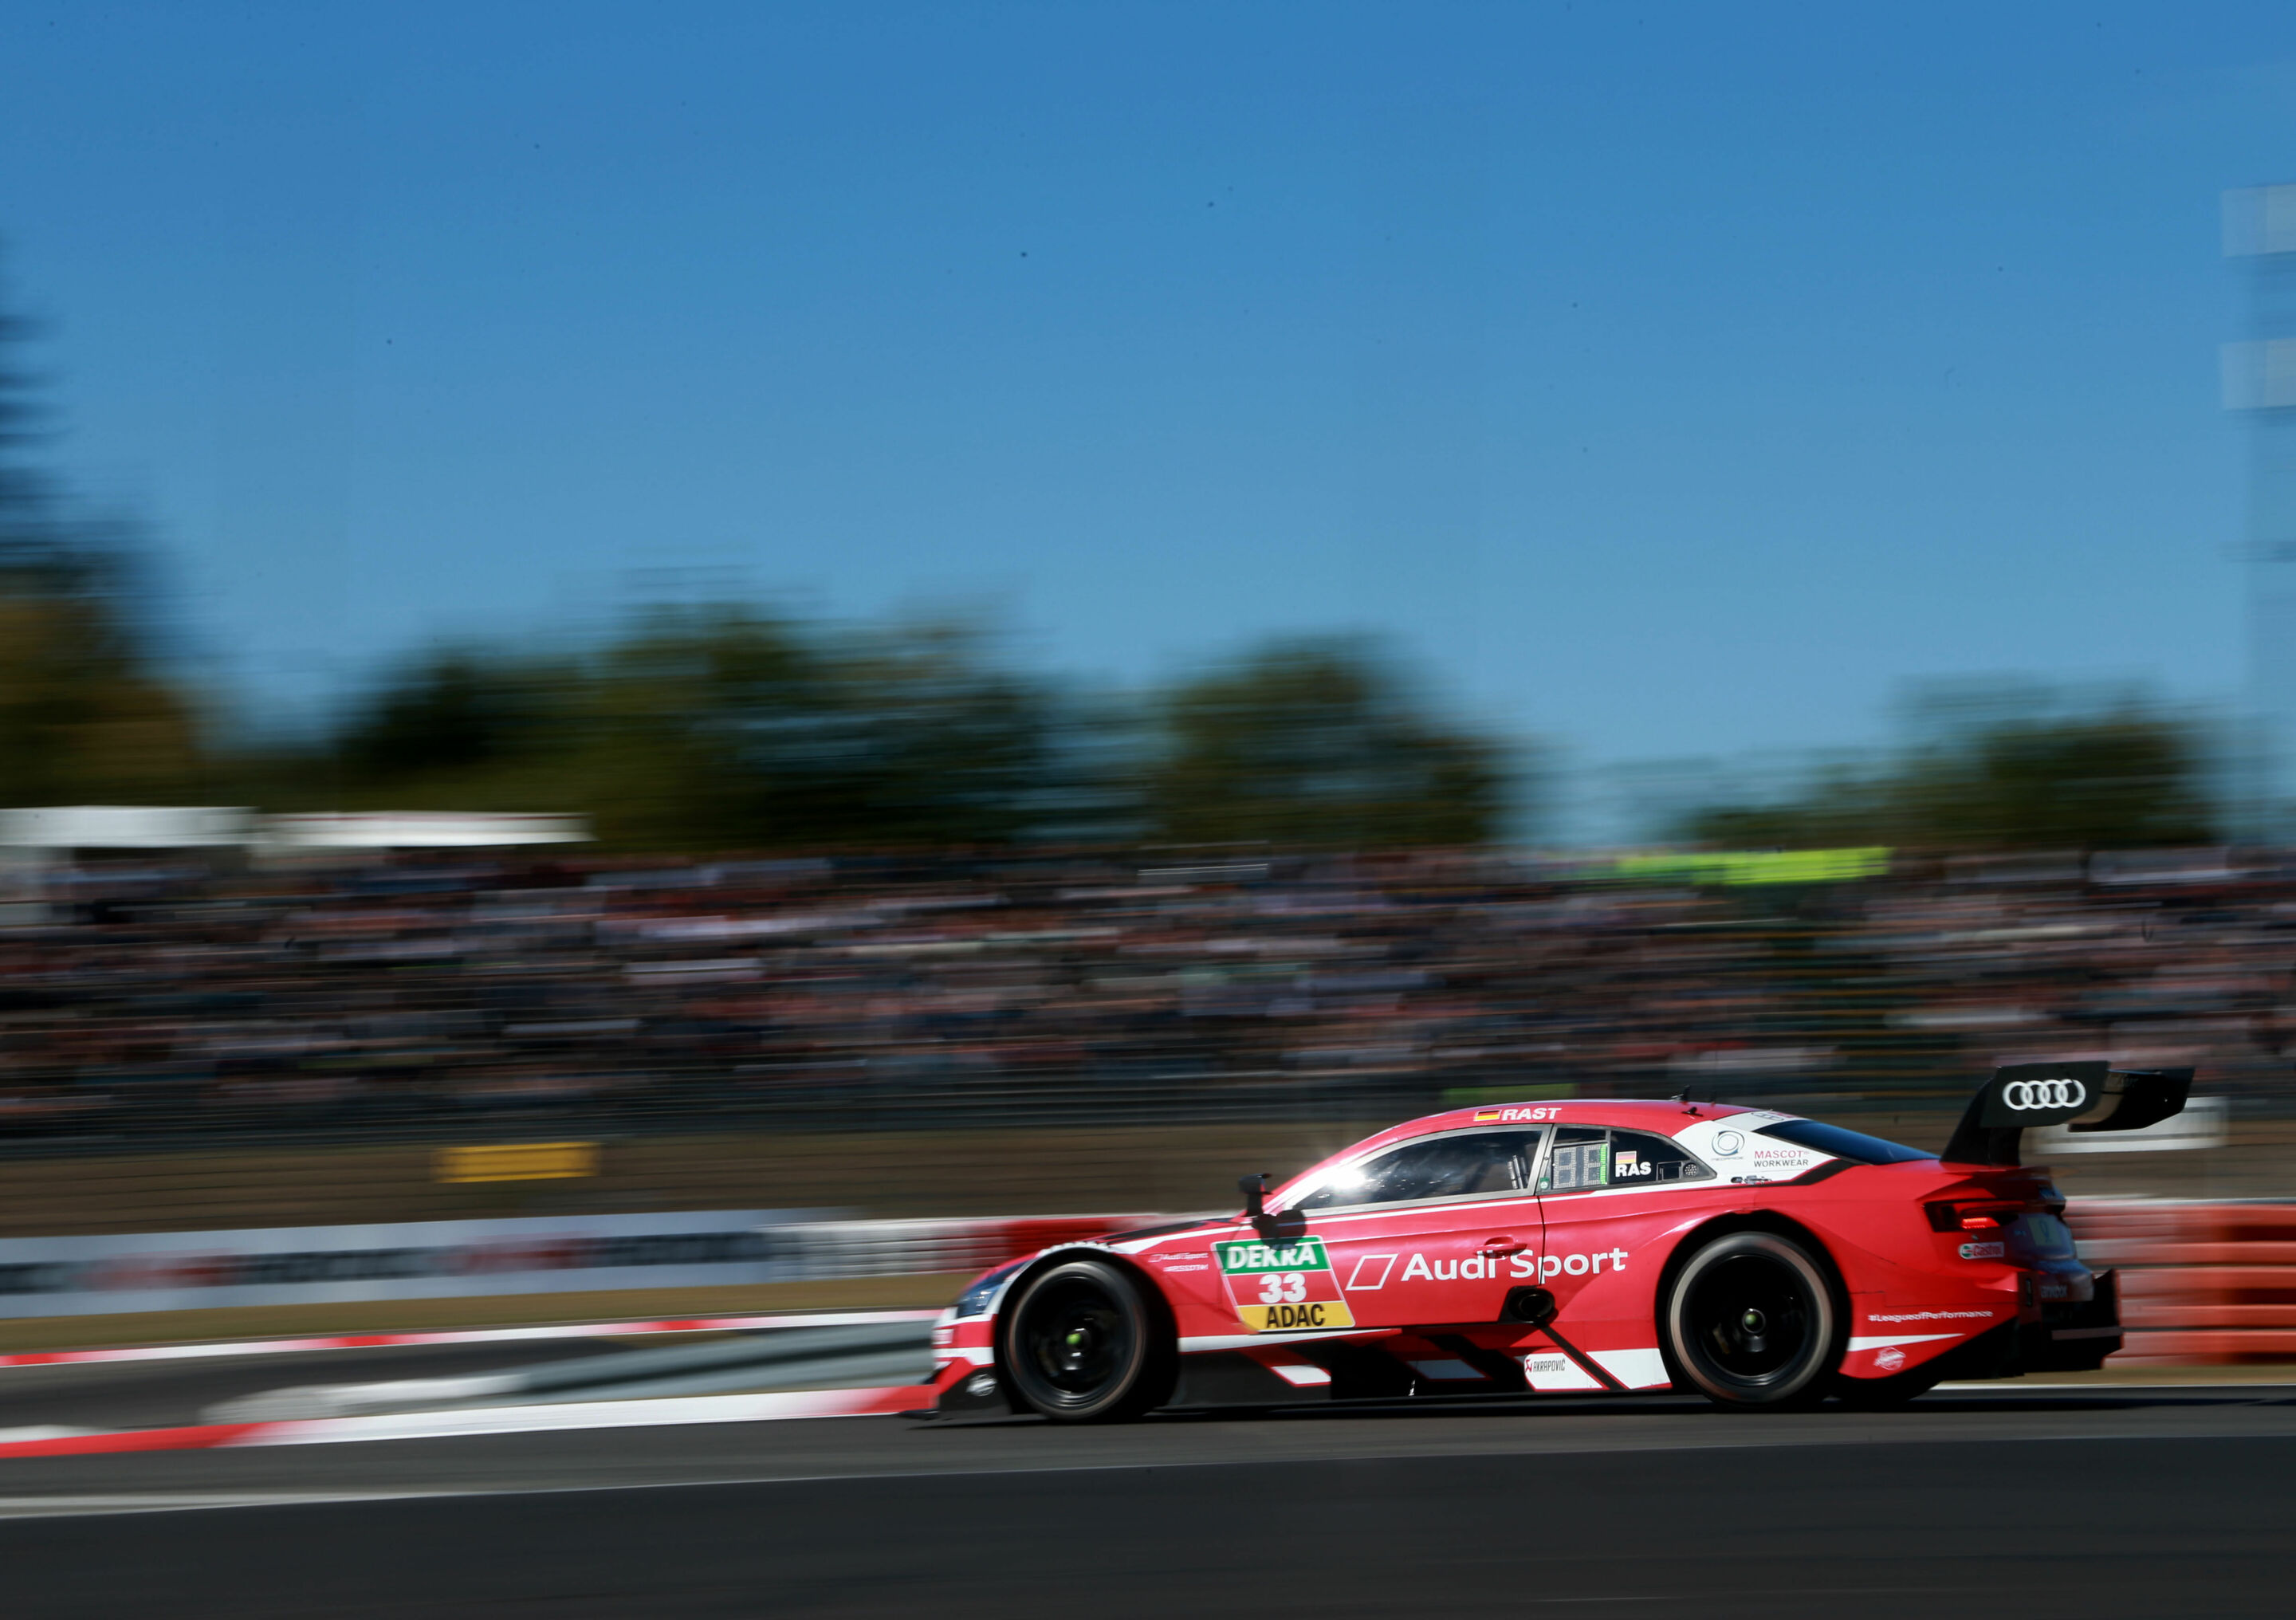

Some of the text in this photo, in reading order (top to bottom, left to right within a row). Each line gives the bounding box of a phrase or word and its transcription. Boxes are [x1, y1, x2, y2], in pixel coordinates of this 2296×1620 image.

[1502, 1107, 1563, 1121] RAST
[1615, 1162, 1652, 1178] RAS
[1754, 1159, 1809, 1168] WORKWEAR
[1227, 1244, 1318, 1269] DEKRA
[1401, 1248, 1629, 1284] Audi Sport
[1259, 1273, 1307, 1303] 33
[1266, 1303, 1326, 1329] ADAC
